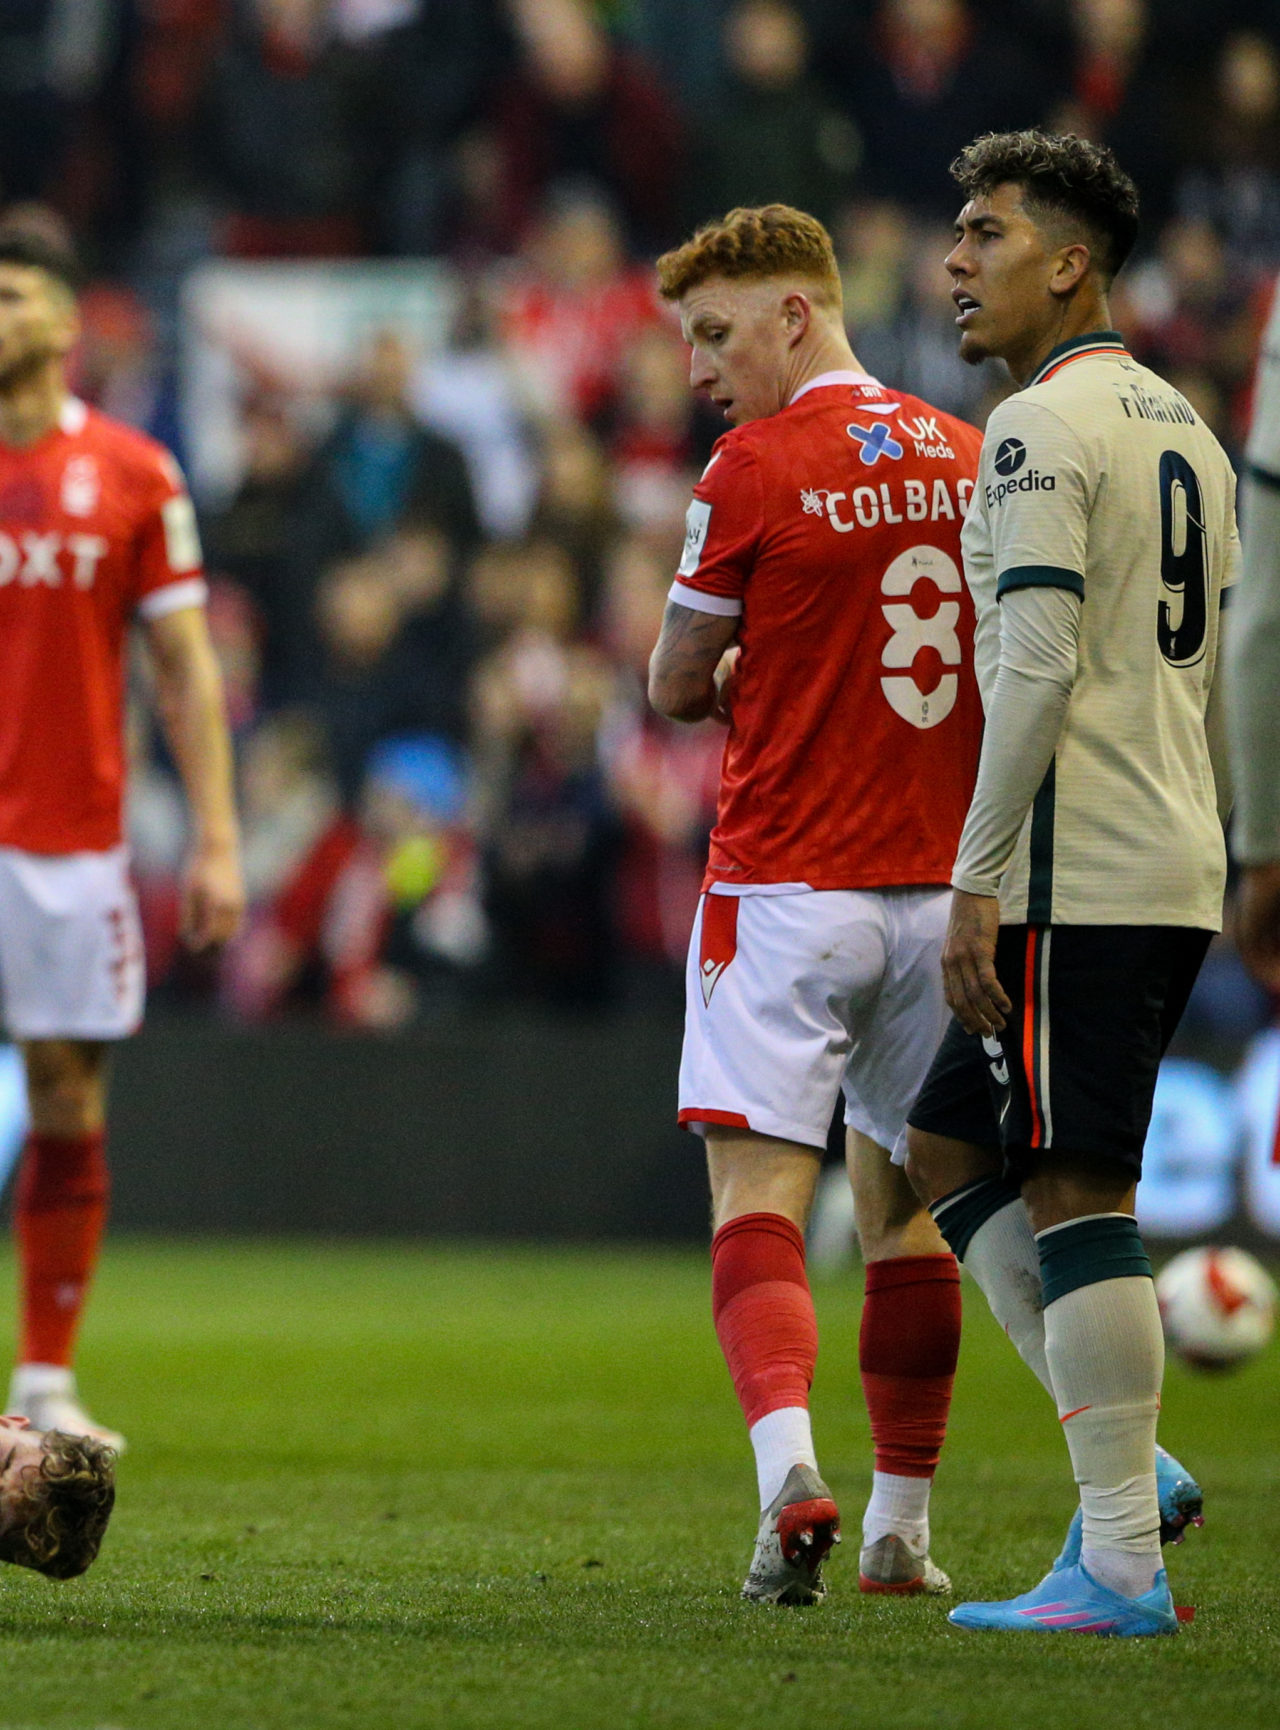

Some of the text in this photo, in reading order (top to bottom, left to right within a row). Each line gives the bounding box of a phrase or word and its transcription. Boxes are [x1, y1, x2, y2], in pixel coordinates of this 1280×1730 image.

[897, 416, 948, 442] UK
[913, 440, 955, 460] Meds
[825, 479, 977, 533] COLBAC
[985, 469, 1055, 509] Expedia
[1156, 449, 1209, 668] 9
[880, 544, 962, 729] 8
